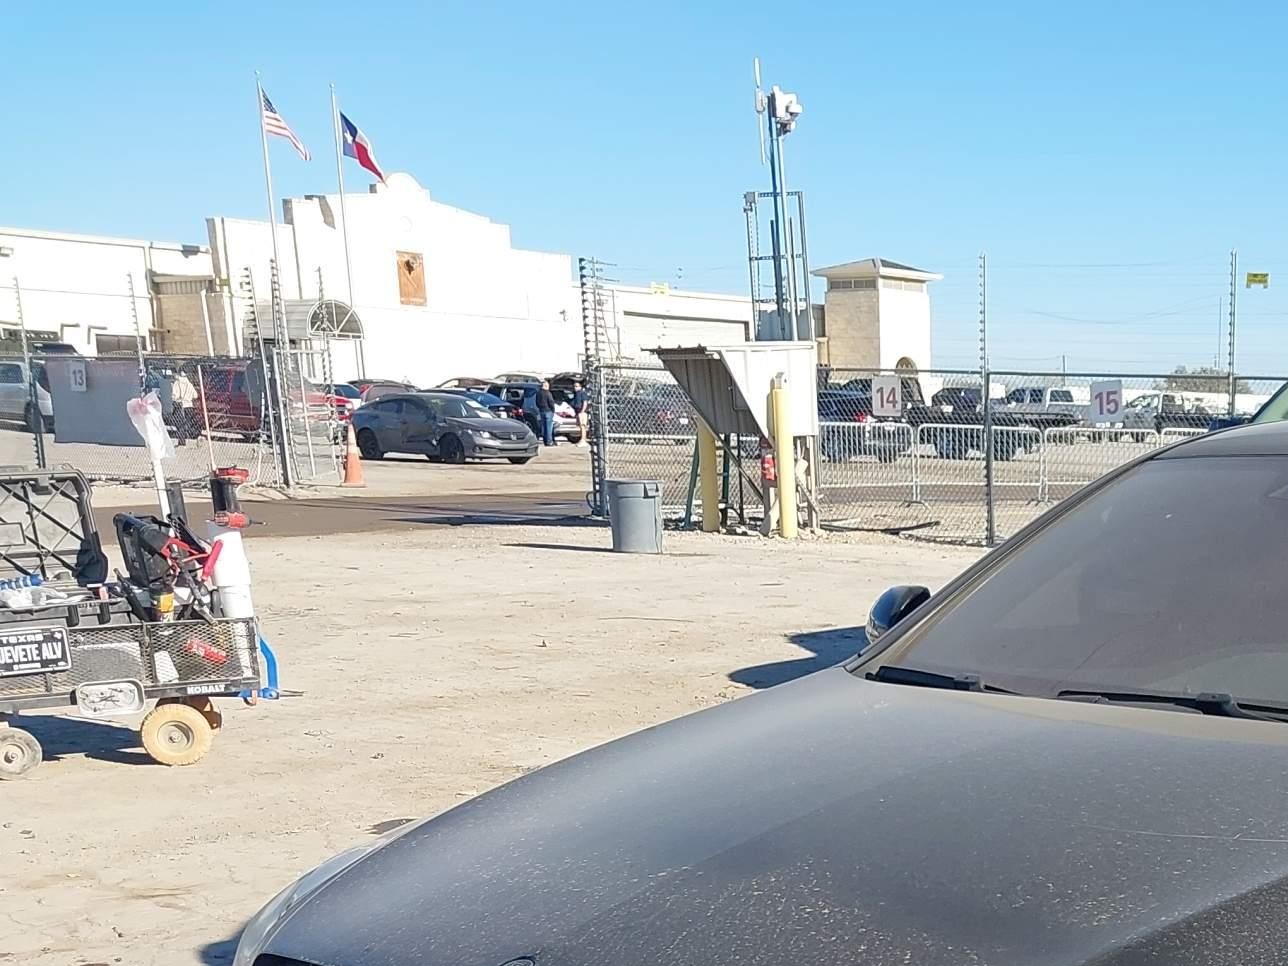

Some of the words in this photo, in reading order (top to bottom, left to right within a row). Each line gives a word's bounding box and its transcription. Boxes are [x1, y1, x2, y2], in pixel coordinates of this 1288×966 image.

[72, 369, 84, 386] 13
[876, 387, 898, 409] 14
[1095, 391, 1119, 415] 15
[2, 633, 44, 644] TEXAS
[42, 641, 62, 660] ALV
[187, 684, 226, 695] KOBALT
